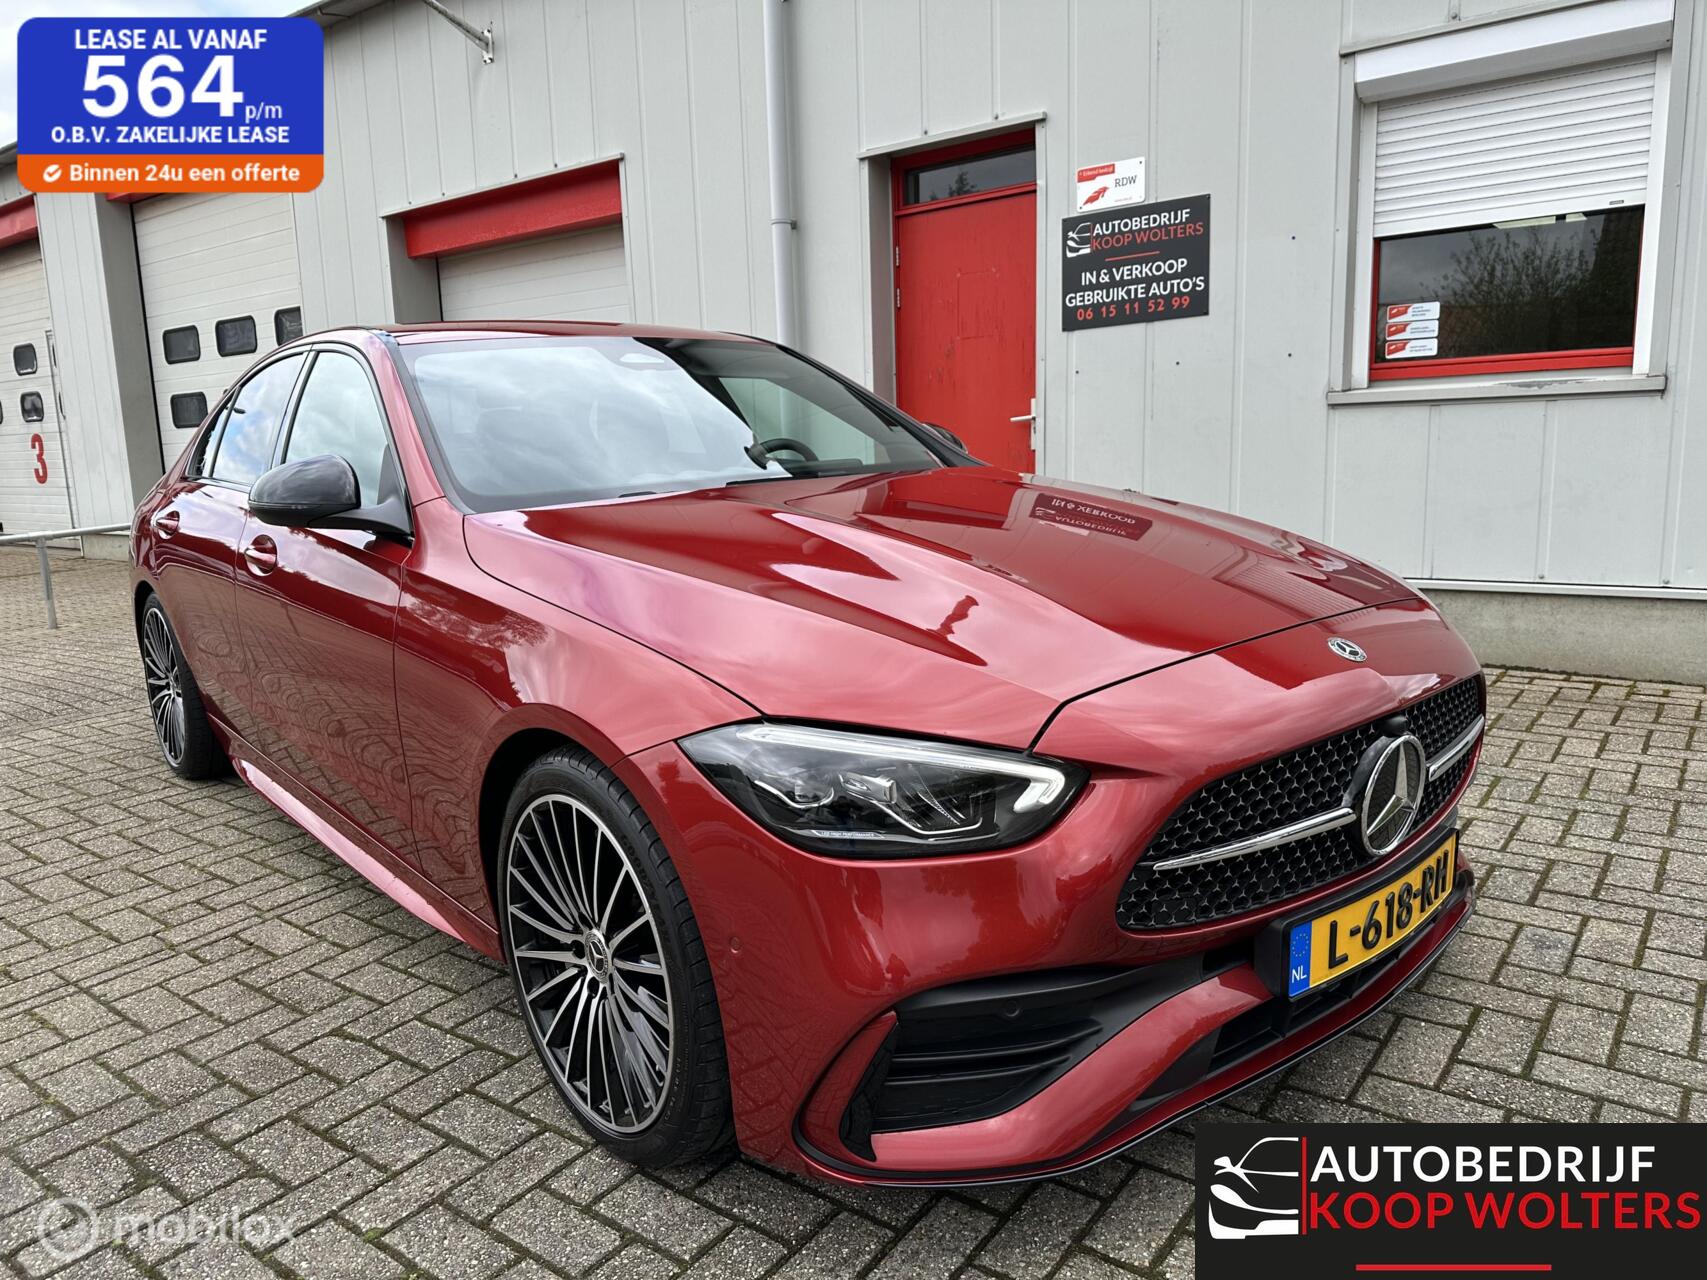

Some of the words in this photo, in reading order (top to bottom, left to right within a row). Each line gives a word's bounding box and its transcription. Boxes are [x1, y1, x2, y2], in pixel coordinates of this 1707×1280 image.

[1114, 174, 1137, 188] RDW
[1092, 233, 1132, 250] KOOP
[1136, 222, 1204, 244] WOLTERS
[1093, 209, 1191, 237] AUTOBEDRIJF
[1081, 271, 1096, 286] IN
[1099, 269, 1110, 283] &
[1113, 258, 1187, 281] VERKOOP
[1066, 284, 1146, 307] GEBRUIKTE
[1149, 276, 1205, 297] AUTO'S
[1077, 307, 1093, 321] 06
[1101, 304, 1116, 318] 15
[1124, 302, 1140, 315] 11
[1148, 299, 1165, 312] 52
[1171, 296, 1190, 309] 99
[31, 433, 48, 484] 3
[1328, 849, 1449, 970] L-618-RH
[1291, 965, 1307, 983] NL
